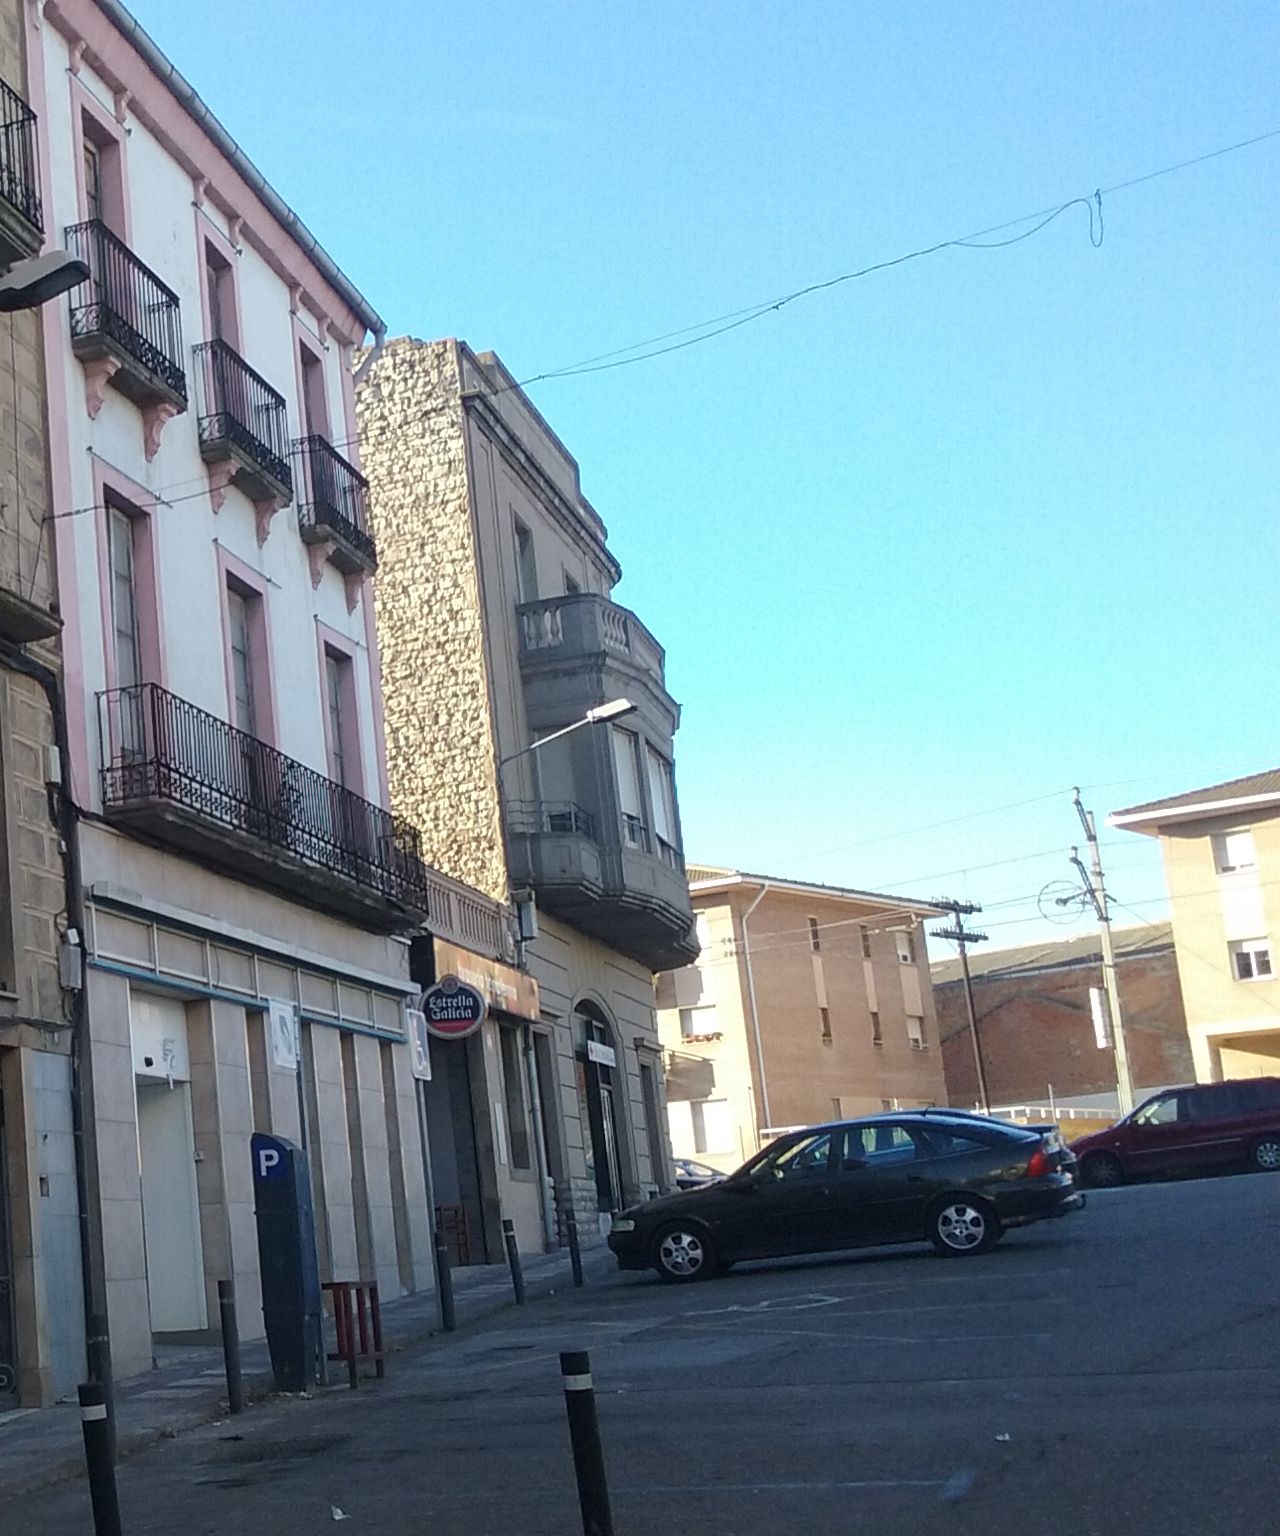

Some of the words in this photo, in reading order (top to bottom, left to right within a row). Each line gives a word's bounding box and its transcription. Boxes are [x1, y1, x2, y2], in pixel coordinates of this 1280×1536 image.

[429, 995, 473, 1008] Estrella
[431, 1007, 472, 1019] Galicia
[260, 1149, 279, 1176] P
